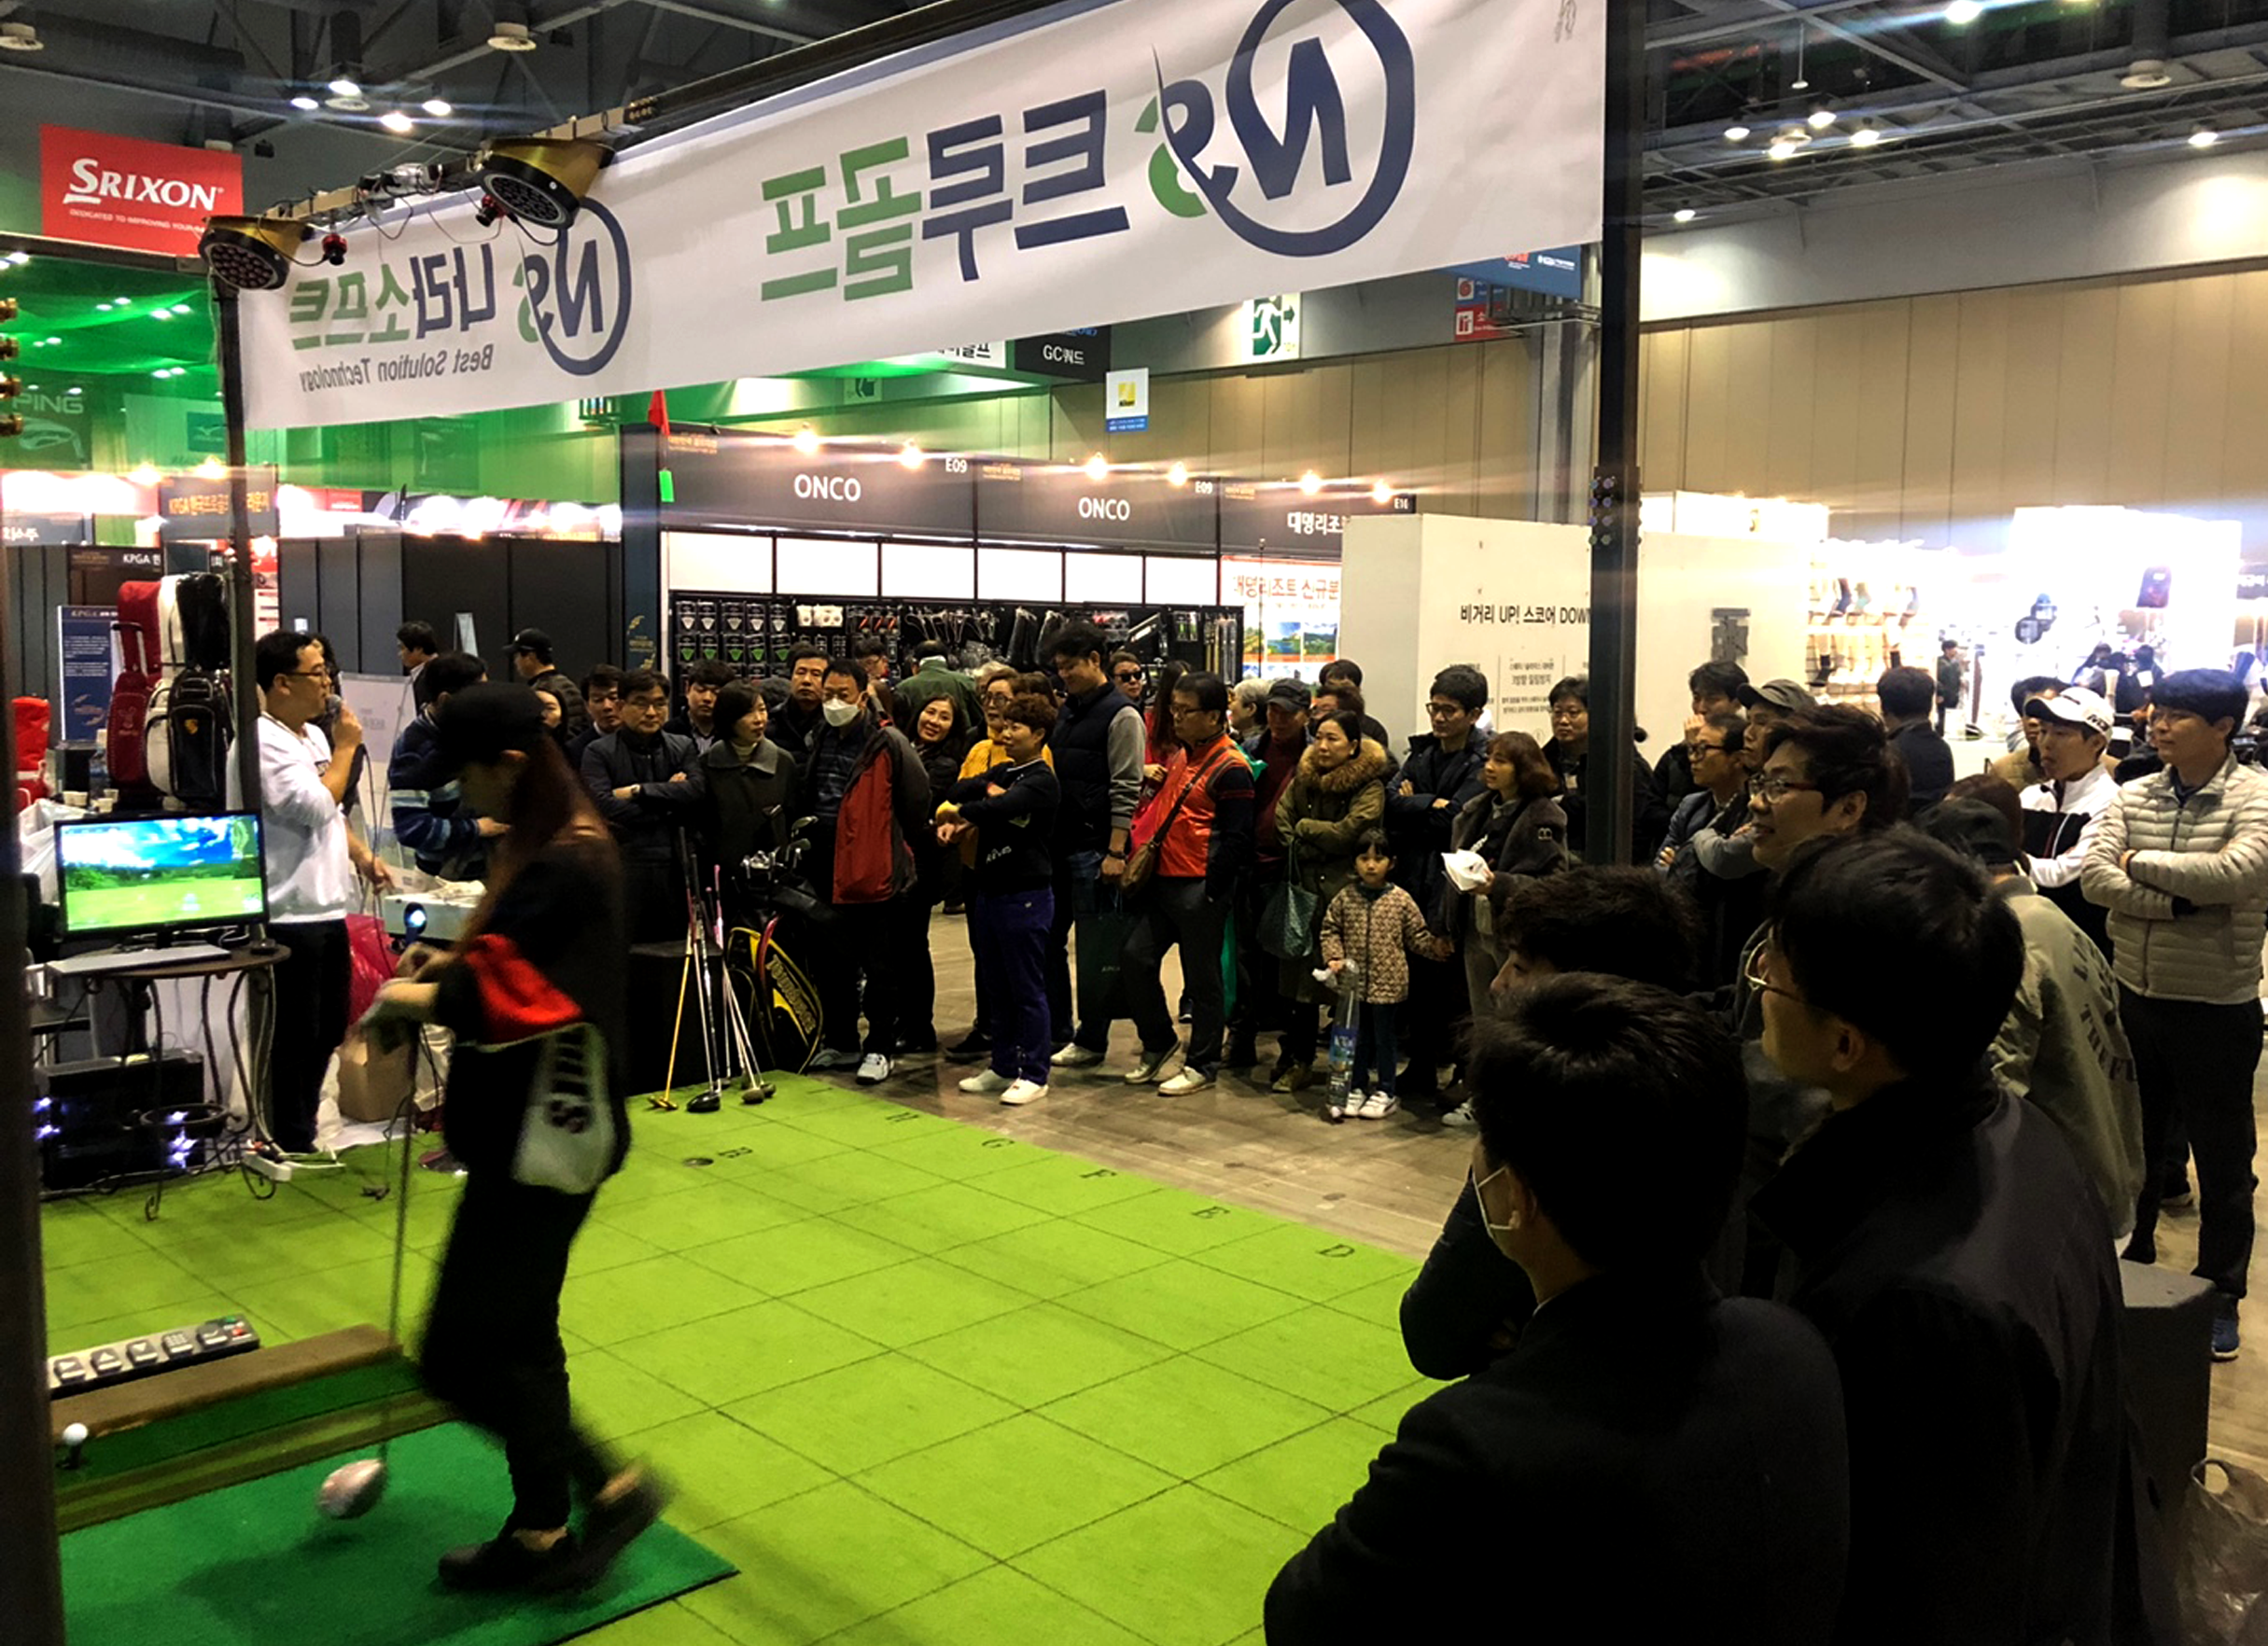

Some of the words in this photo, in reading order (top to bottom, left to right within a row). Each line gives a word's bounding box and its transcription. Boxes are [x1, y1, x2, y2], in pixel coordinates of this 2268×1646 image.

[63, 158, 217, 212] SRIXON
[12, 392, 84, 414] PING
[945, 457, 968, 473] E09
[793, 473, 861, 502] ONCO
[1195, 481, 1213, 495] E09
[1078, 496, 1130, 521] ONCO
[1287, 511, 1345, 536] 대명리조
[1301, 579, 1339, 600] 신규분
[1461, 605, 1494, 624] 비거리
[1500, 606, 1519, 624] UP!
[1523, 606, 1556, 624] 스코어
